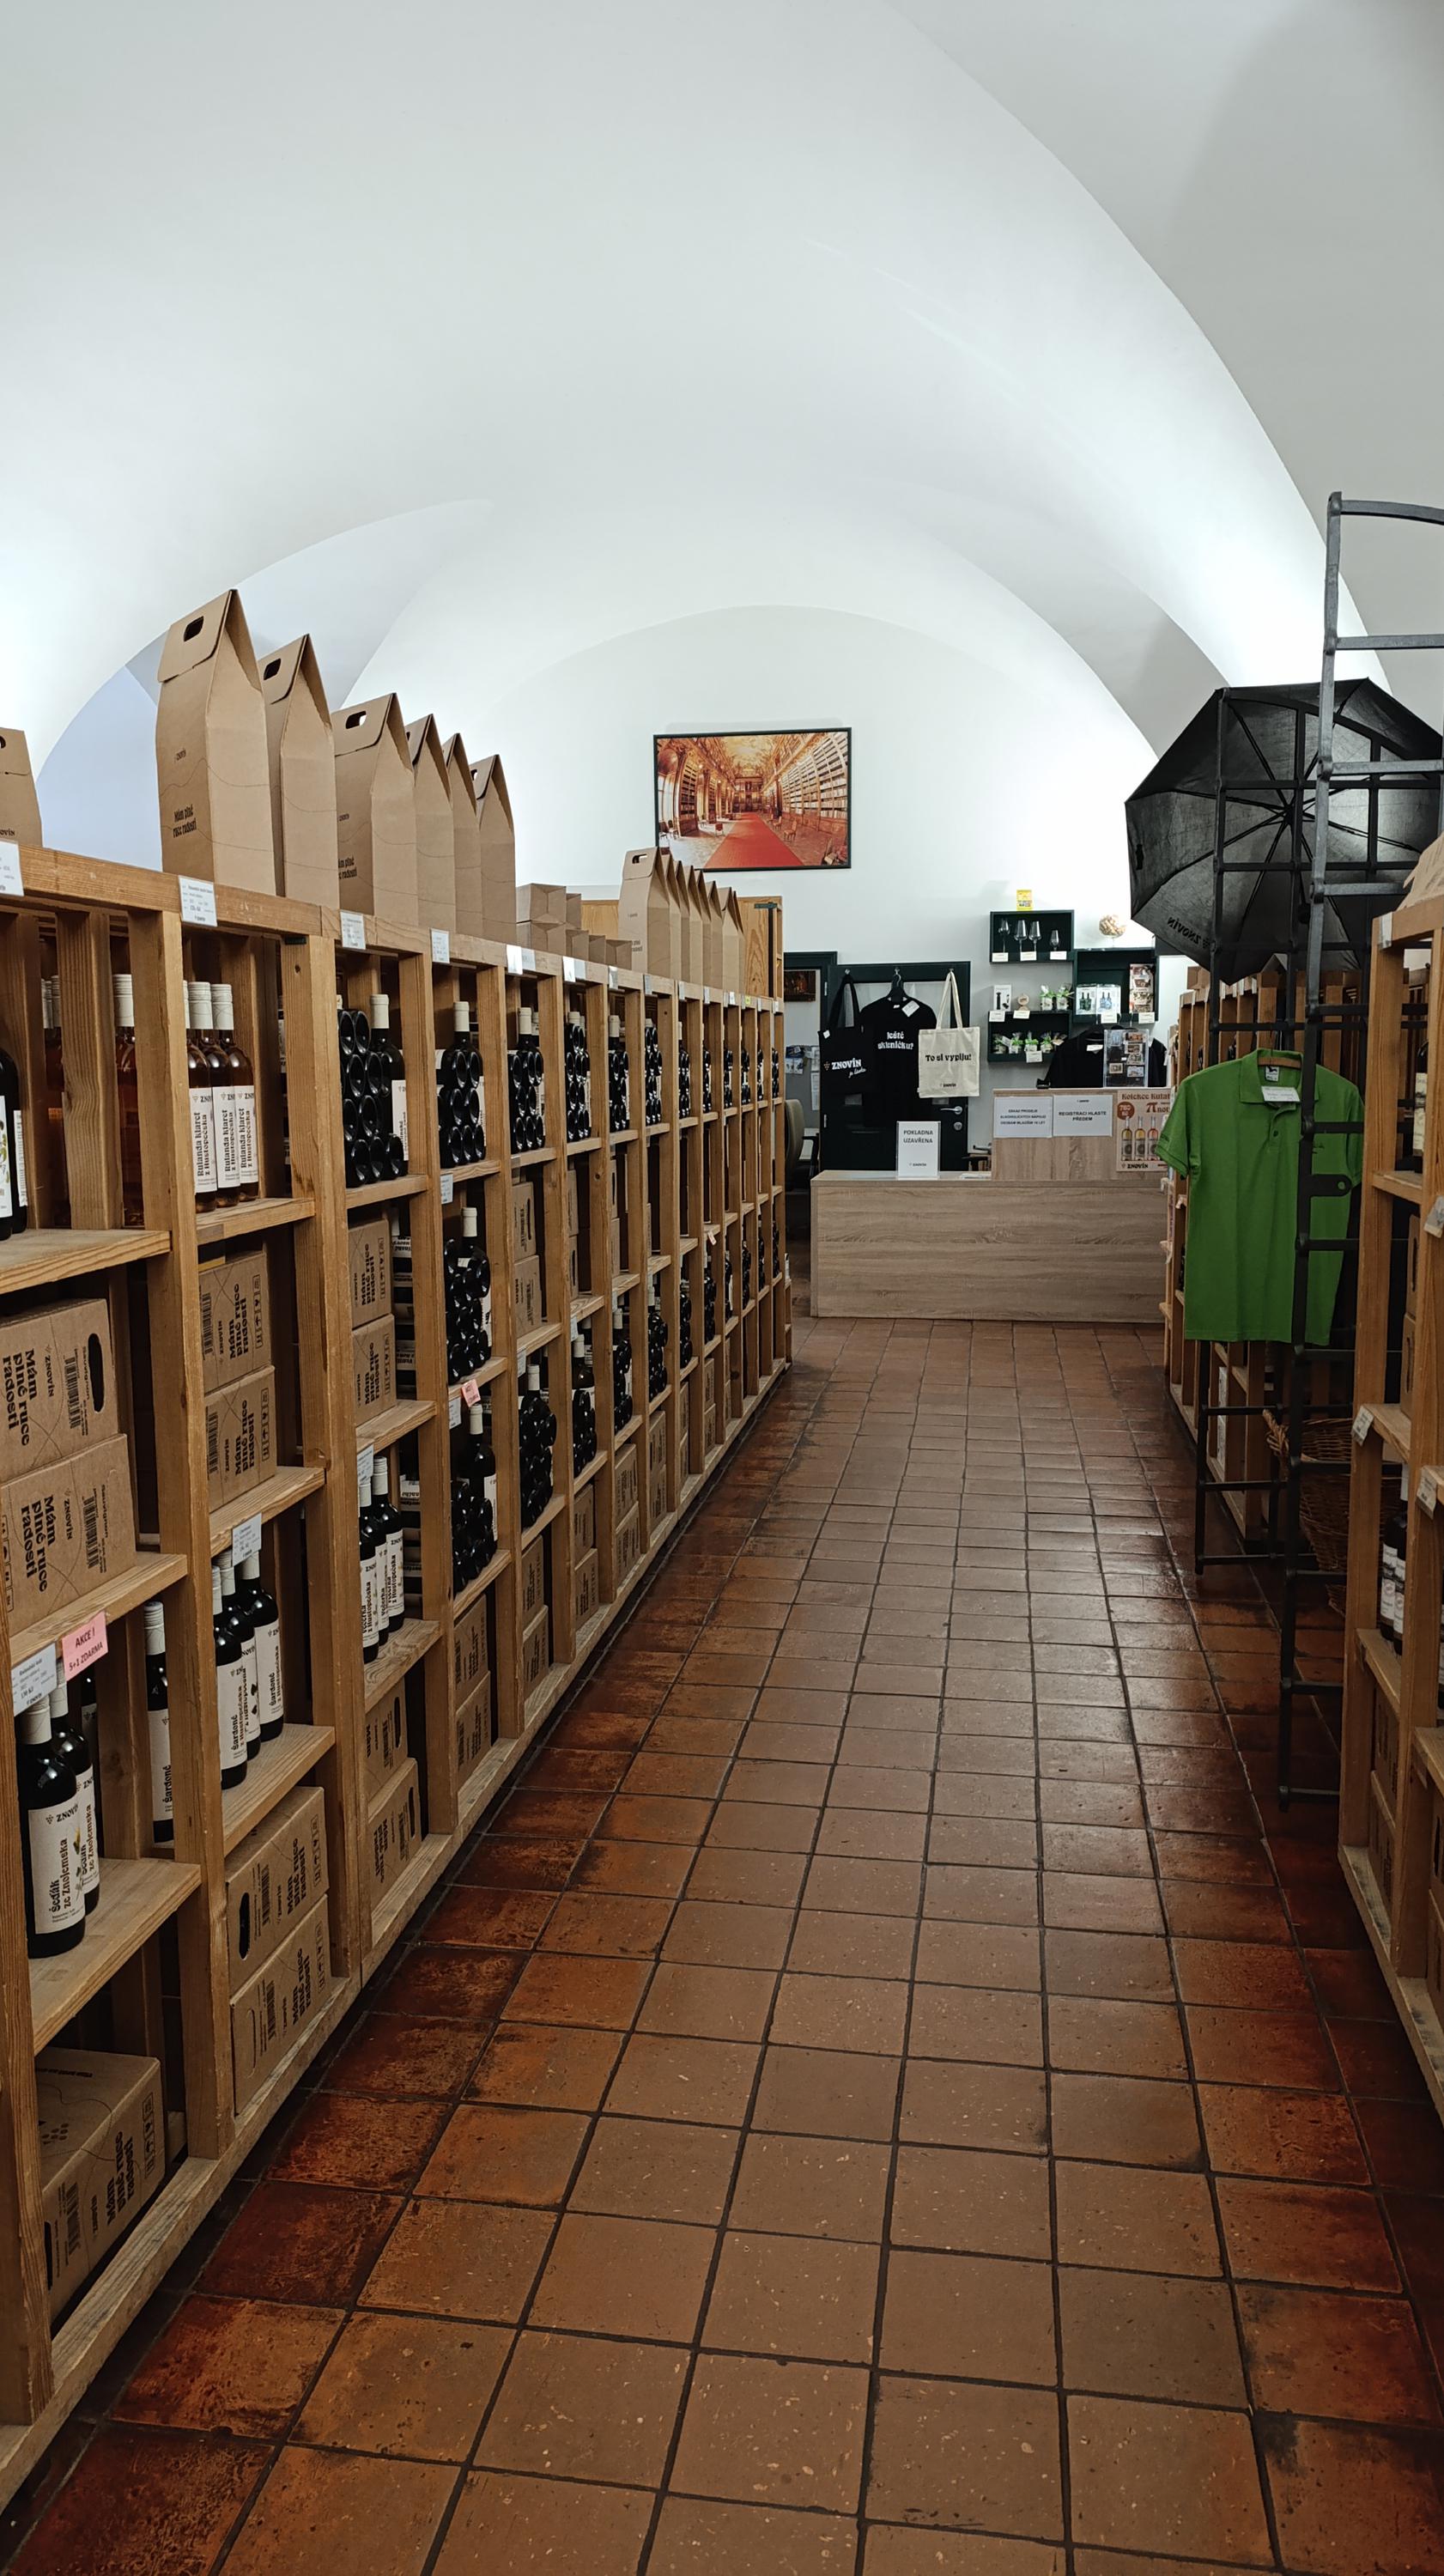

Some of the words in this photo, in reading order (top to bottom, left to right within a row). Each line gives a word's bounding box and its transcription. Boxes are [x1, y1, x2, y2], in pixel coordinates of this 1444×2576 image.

[832, 1058, 862, 1070] ZNOVÍN
[945, 1054, 971, 1062] vypiju!
[3, 1356, 20, 1430] radosti
[13, 1353, 28, 1397] plné
[26, 1348, 38, 1400] Mám
[45, 1355, 55, 1398] ZNOVÍN
[19, 1400, 30, 1446] ruce
[32, 1500, 46, 1545] plné
[44, 1494, 57, 1547] Mám
[64, 1498, 74, 1540] ZNOVÍN
[21, 1505, 37, 1579] radosti
[37, 1547, 47, 1592] ruce
[69, 1658, 80, 1672] 5+1
[81, 1642, 103, 1664] ZDARMA
[76, 1631, 92, 1648] AKCE
[60, 1838, 71, 1896] Znojemska
[49, 1879, 60, 1913] Šeďák
[64, 1896, 71, 1909] ze
[115, 2131, 124, 2174] ruce
[124, 2136, 135, 2202] radosti
[106, 2177, 116, 2227] Mám
[116, 2172, 126, 2213] plné
